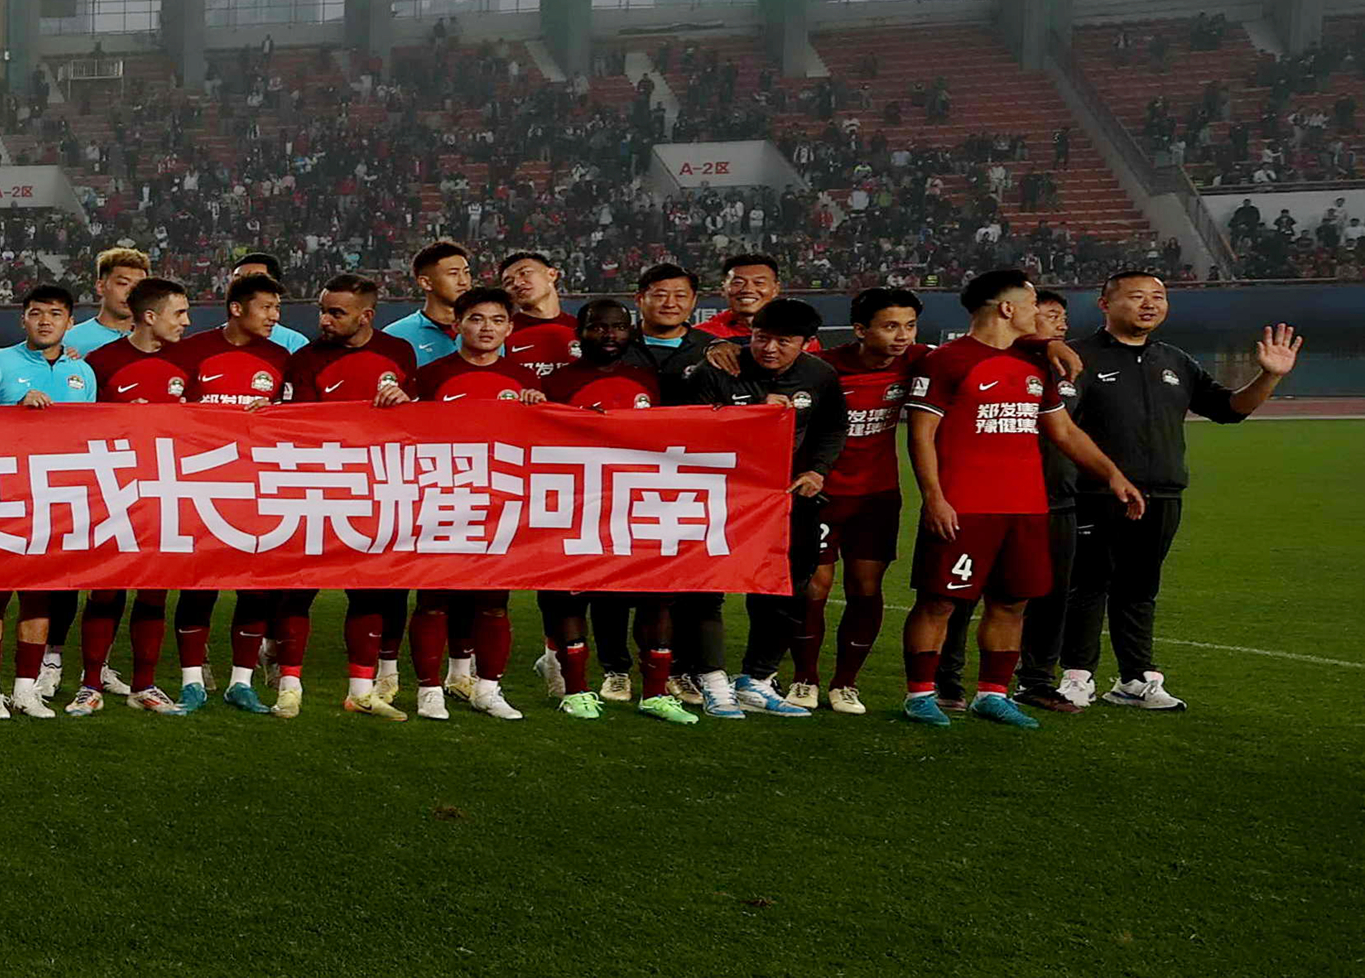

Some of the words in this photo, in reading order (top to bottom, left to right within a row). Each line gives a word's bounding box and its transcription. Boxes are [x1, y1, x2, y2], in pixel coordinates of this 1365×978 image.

[679, 161, 731, 175] A-2区
[976, 402, 1039, 419] 郑发集
[975, 418, 1039, 434] 豫健集
[951, 553, 973, 581] 4
